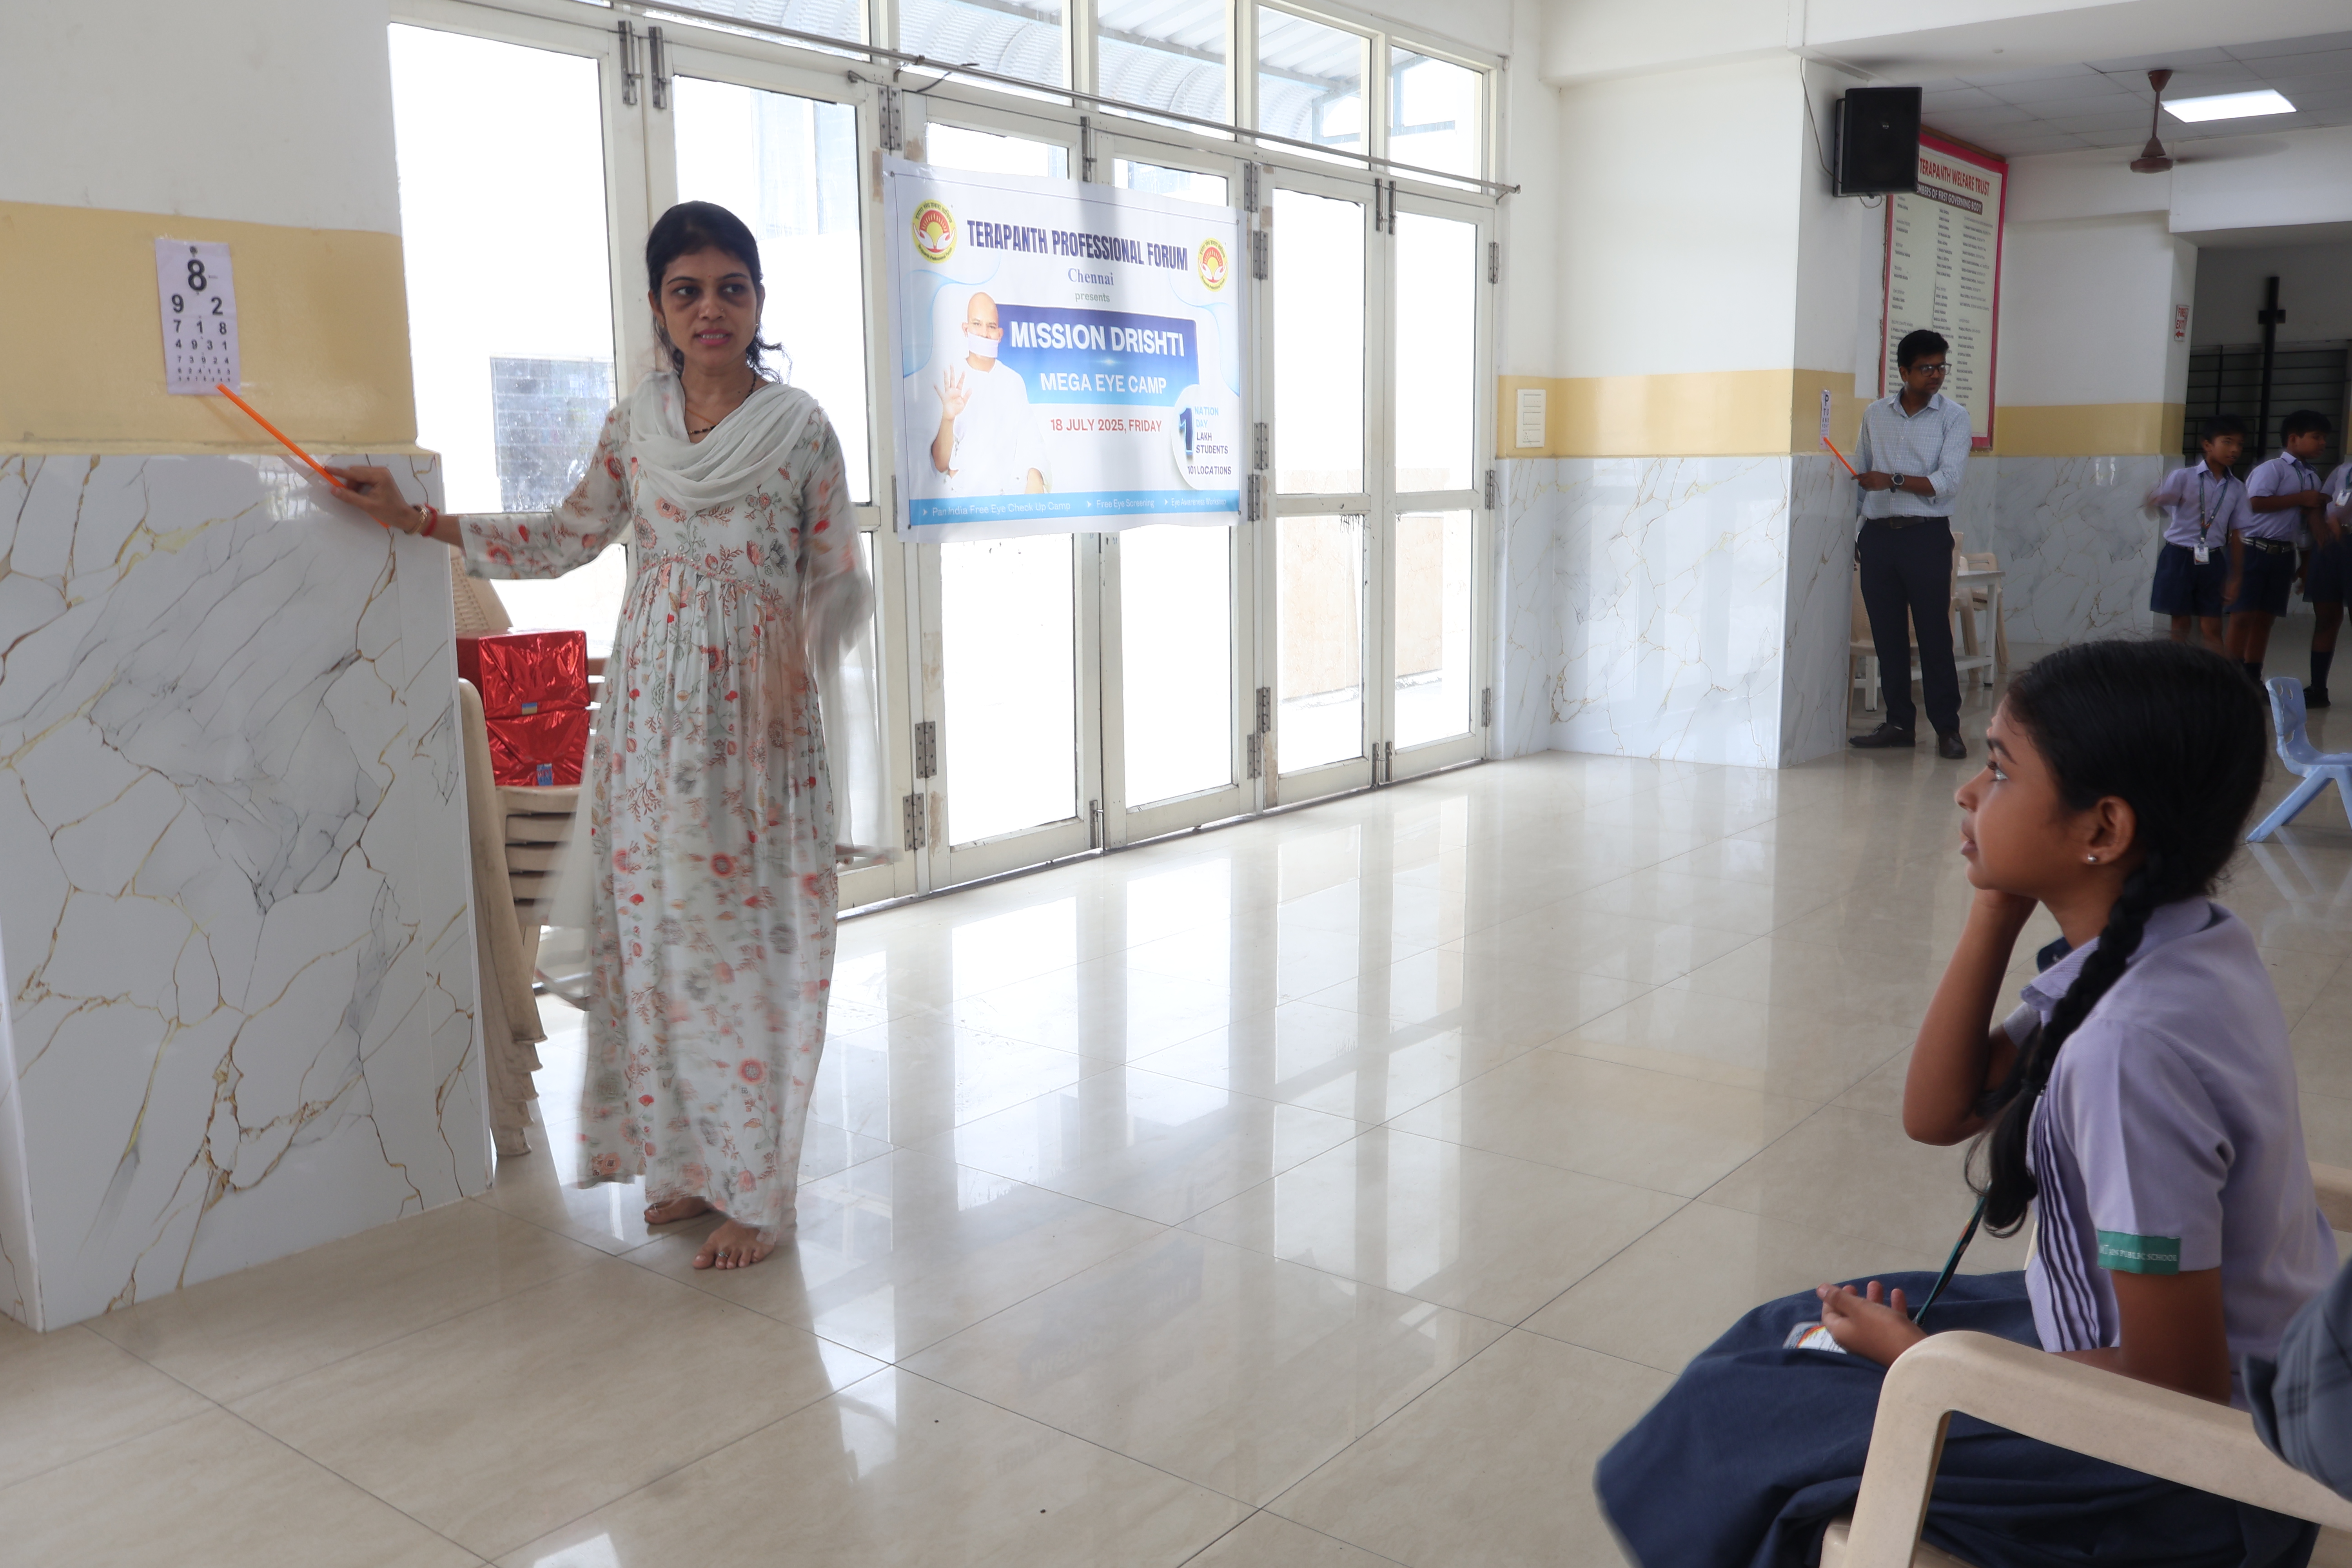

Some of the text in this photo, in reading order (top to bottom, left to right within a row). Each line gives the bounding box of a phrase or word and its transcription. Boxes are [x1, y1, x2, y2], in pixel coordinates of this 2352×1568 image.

[1920, 158, 1990, 196] TERAPANTH WELFARE TRUST
[1932, 189, 1938, 198] OF
[1938, 190, 1948, 201] FIRST
[1948, 194, 1971, 209] GOVERNING
[1971, 200, 1982, 212] BODY
[967, 220, 1048, 254] TERAPANTH
[1052, 230, 1144, 265] PROFESSIONAL
[1147, 242, 1188, 271] FORUM
[187, 259, 207, 292] 8
[1068, 268, 1114, 285] Chennai
[1075, 292, 1110, 302] presents
[172, 294, 223, 315] 9 2
[174, 319, 227, 335] 7 1 8
[176, 339, 227, 350] 4 9 3 1
[1011, 321, 1185, 357] MISSION DRISHTI
[1040, 373, 1167, 394] MEGA EYE CAMP
[1825, 394, 1829, 406] P
[1194, 406, 1219, 416] NATION
[1051, 419, 1161, 434] 18 JULY 2025, FRIDAY
[1180, 407, 1193, 452] 1
[1196, 419, 1208, 428] DAY
[1197, 432, 1212, 441] LAKH
[1196, 445, 1228, 454] STUDENTS
[1188, 465, 1231, 475] 101 LOCATIONS
[933, 502, 1071, 516] Pan India Free Eye Check Up Camp
[1096, 498, 1154, 509] Free Eye Screening
[1171, 497, 1227, 508] Eye Awareness Workshop
